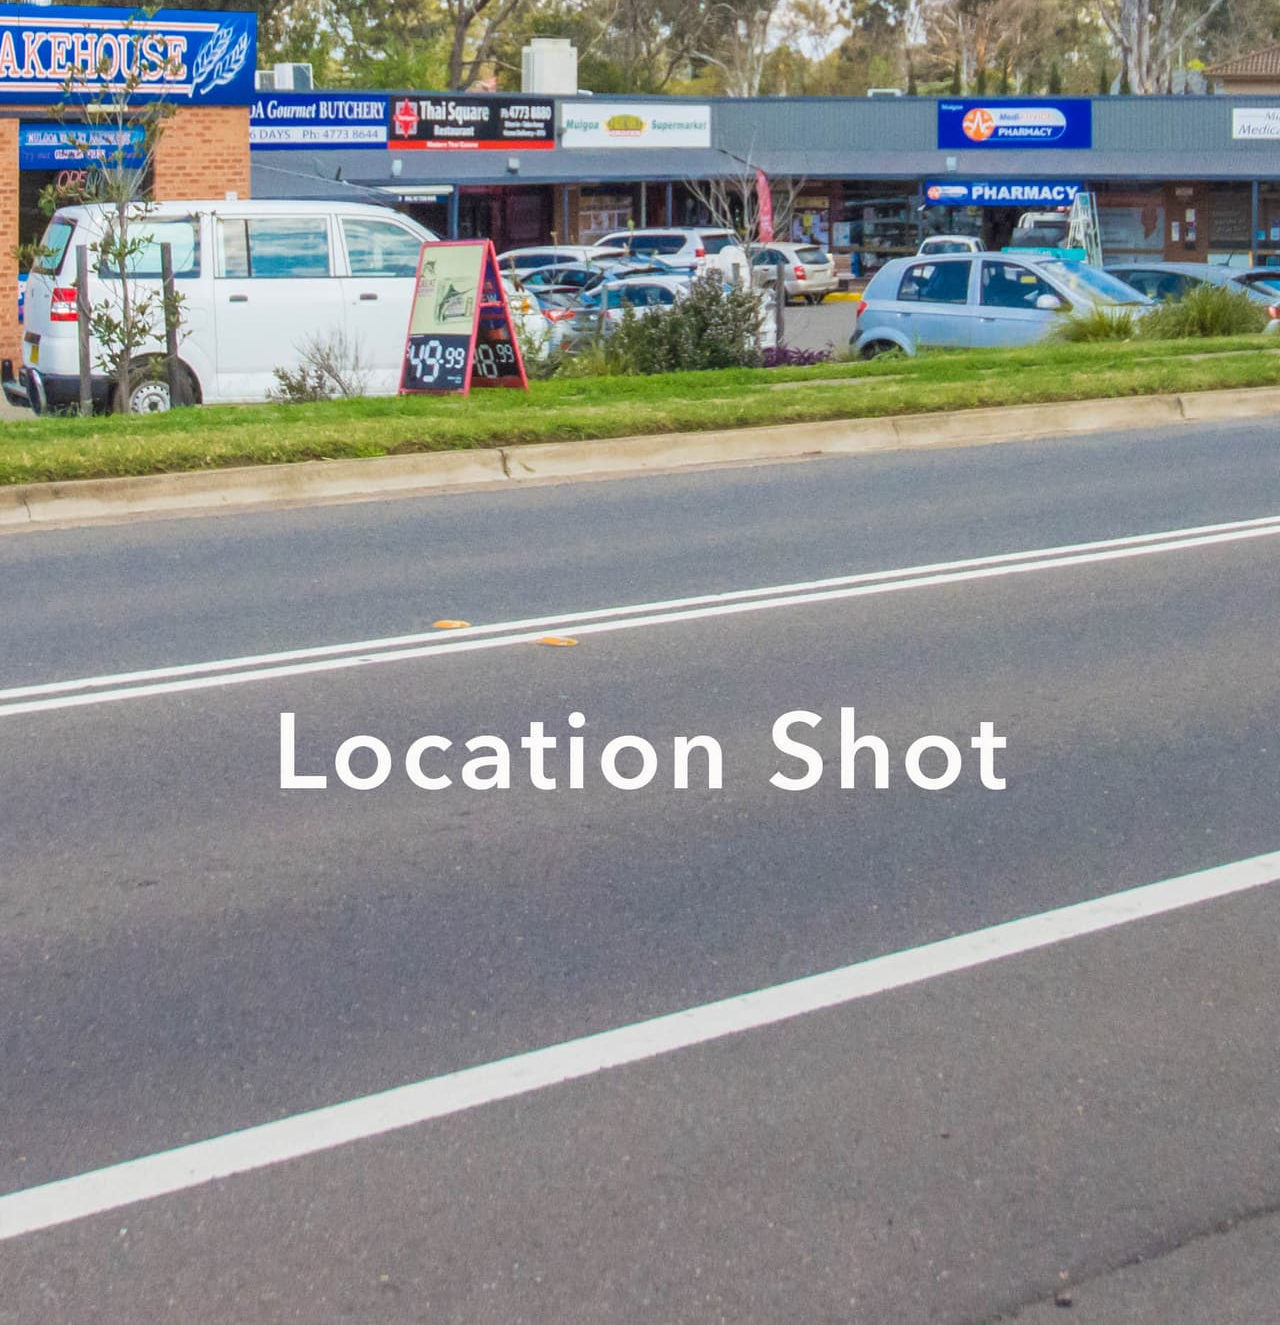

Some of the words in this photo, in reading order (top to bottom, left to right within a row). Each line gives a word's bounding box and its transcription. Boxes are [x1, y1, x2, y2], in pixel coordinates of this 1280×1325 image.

[267, 100, 317, 120] Gourmet
[319, 101, 386, 120] BUTCHERY
[420, 101, 446, 121] Thai
[448, 101, 490, 125] Square
[566, 119, 600, 132] Mulgoa
[651, 119, 707, 132] Supermarket
[998, 127, 1053, 137] PHARMACY
[259, 130, 291, 140] DAYS
[302, 129, 319, 140] Ph:
[322, 130, 349, 140] 4773
[352, 130, 379, 140] 8644
[972, 186, 1079, 201] PHARMACY
